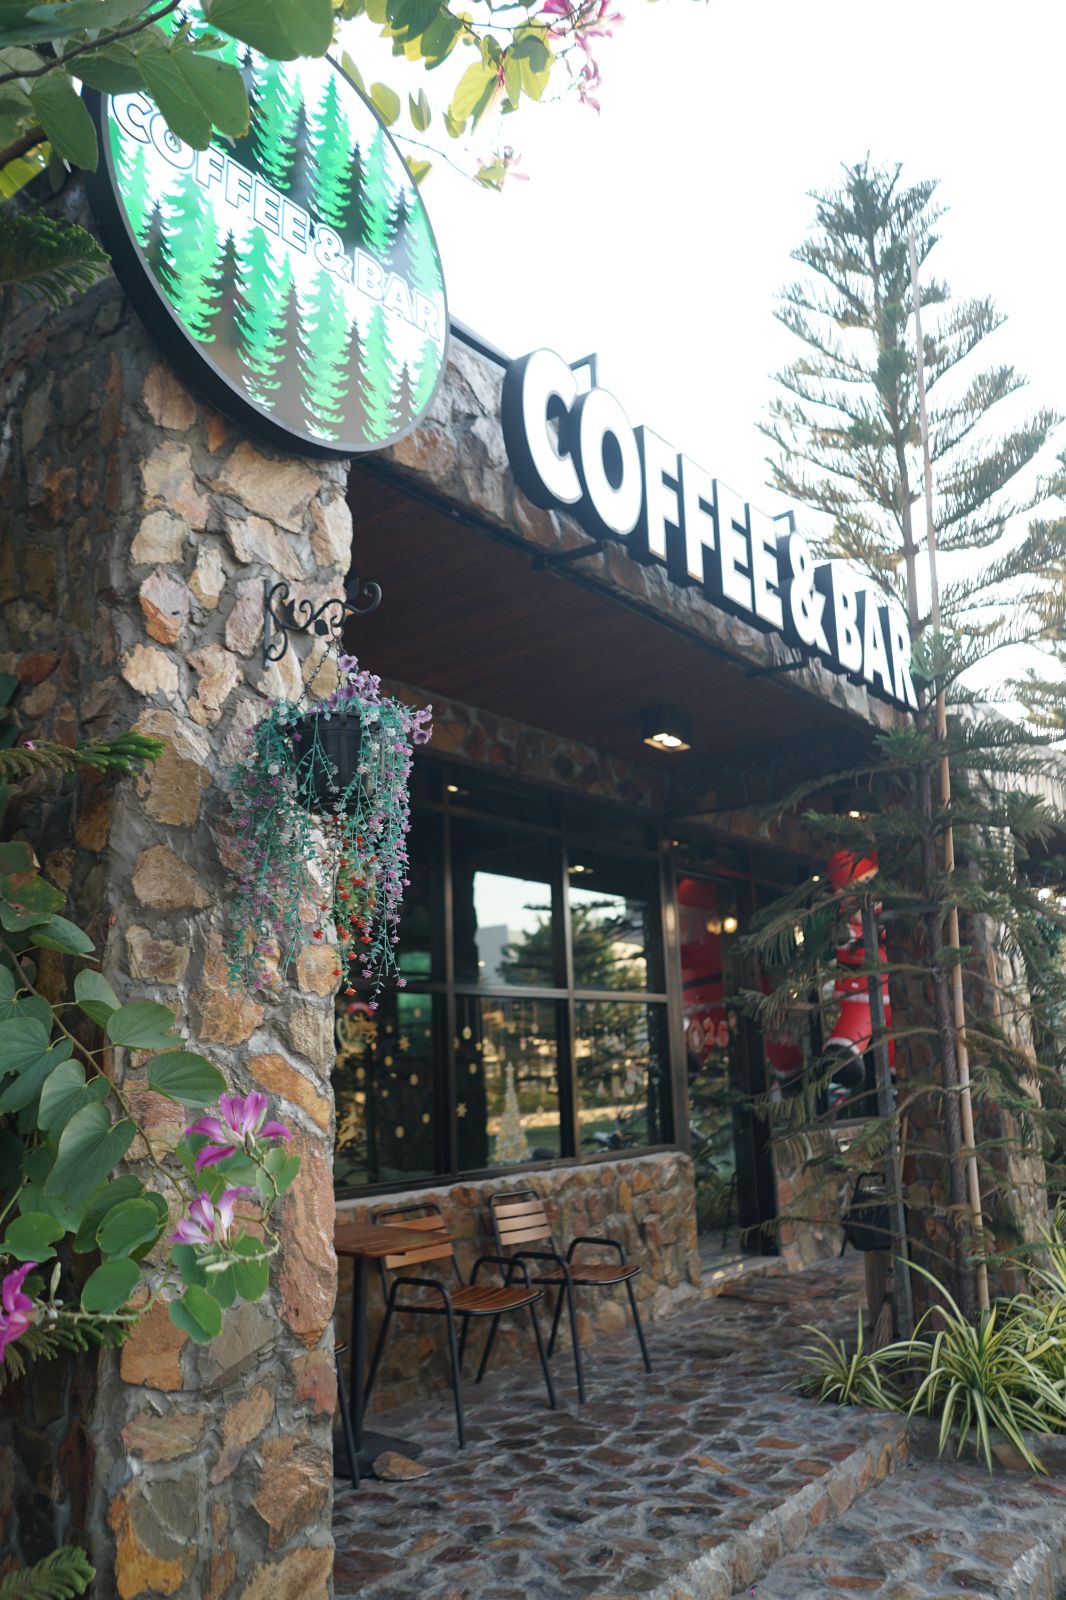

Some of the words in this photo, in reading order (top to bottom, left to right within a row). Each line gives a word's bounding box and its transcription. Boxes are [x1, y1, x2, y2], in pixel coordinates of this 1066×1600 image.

[111, 91, 310, 254] COFFEE
[314, 225, 351, 282] &
[354, 247, 441, 341] BAR
[519, 348, 784, 632] COFFEE
[788, 530, 832, 656] &
[829, 562, 919, 711] BAR
